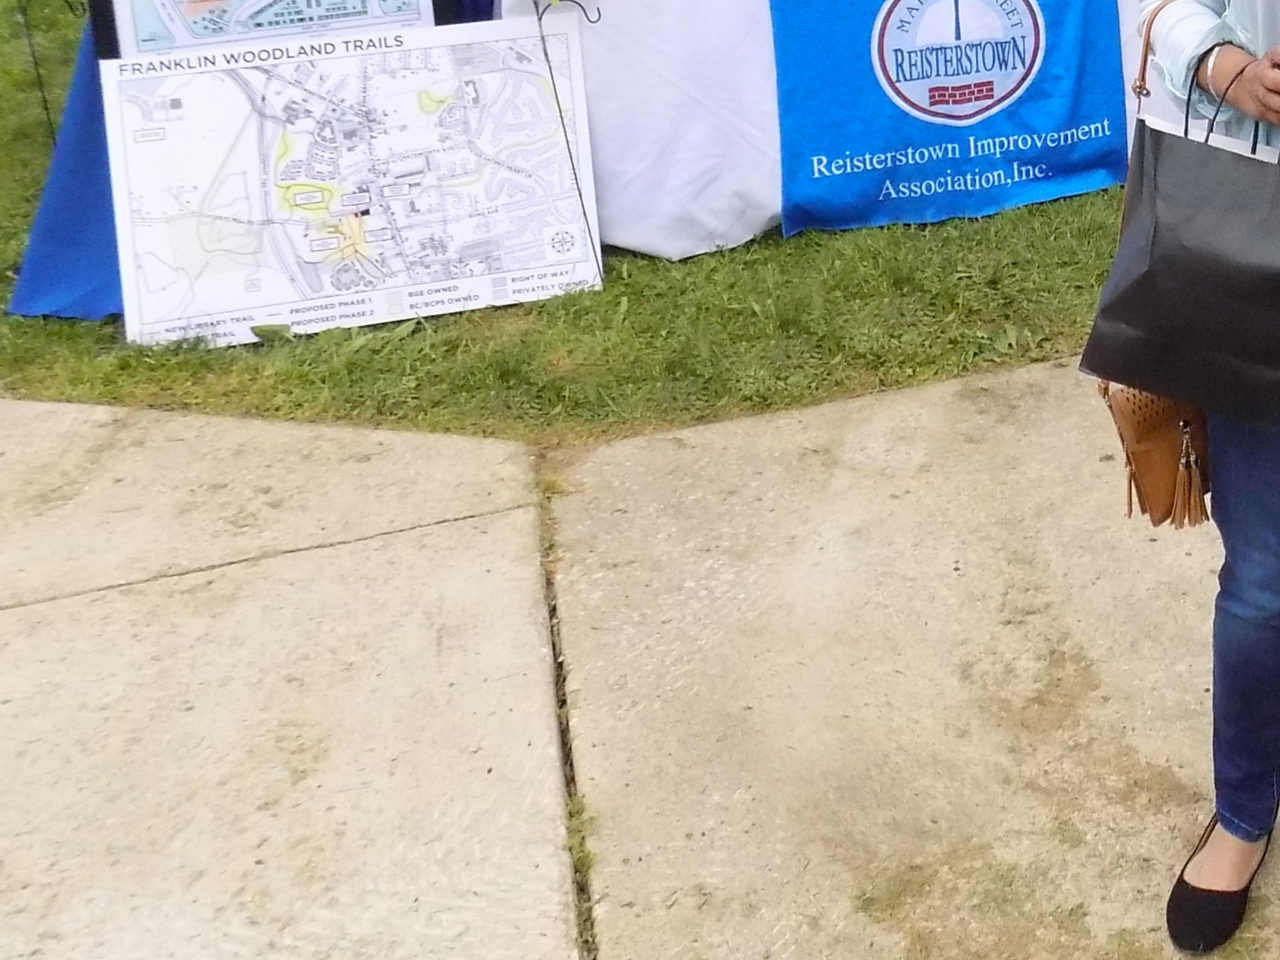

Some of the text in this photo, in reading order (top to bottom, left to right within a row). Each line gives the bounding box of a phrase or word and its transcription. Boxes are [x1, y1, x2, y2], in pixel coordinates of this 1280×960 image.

[119, 35, 404, 76] FRANKLIN WOODLAND TRAILS
[811, 117, 1112, 178] Reisterstown Improvement
[427, 285, 459, 295] OWNED
[512, 284, 555, 295] PRIVATELY
[448, 294, 480, 304] OWNED
[290, 302, 336, 315] PROPOSED
[338, 299, 366, 308] PHASE
[229, 315, 255, 324] TRAIL
[290, 314, 337, 327] PROPOSED
[339, 311, 367, 321] PHASE
